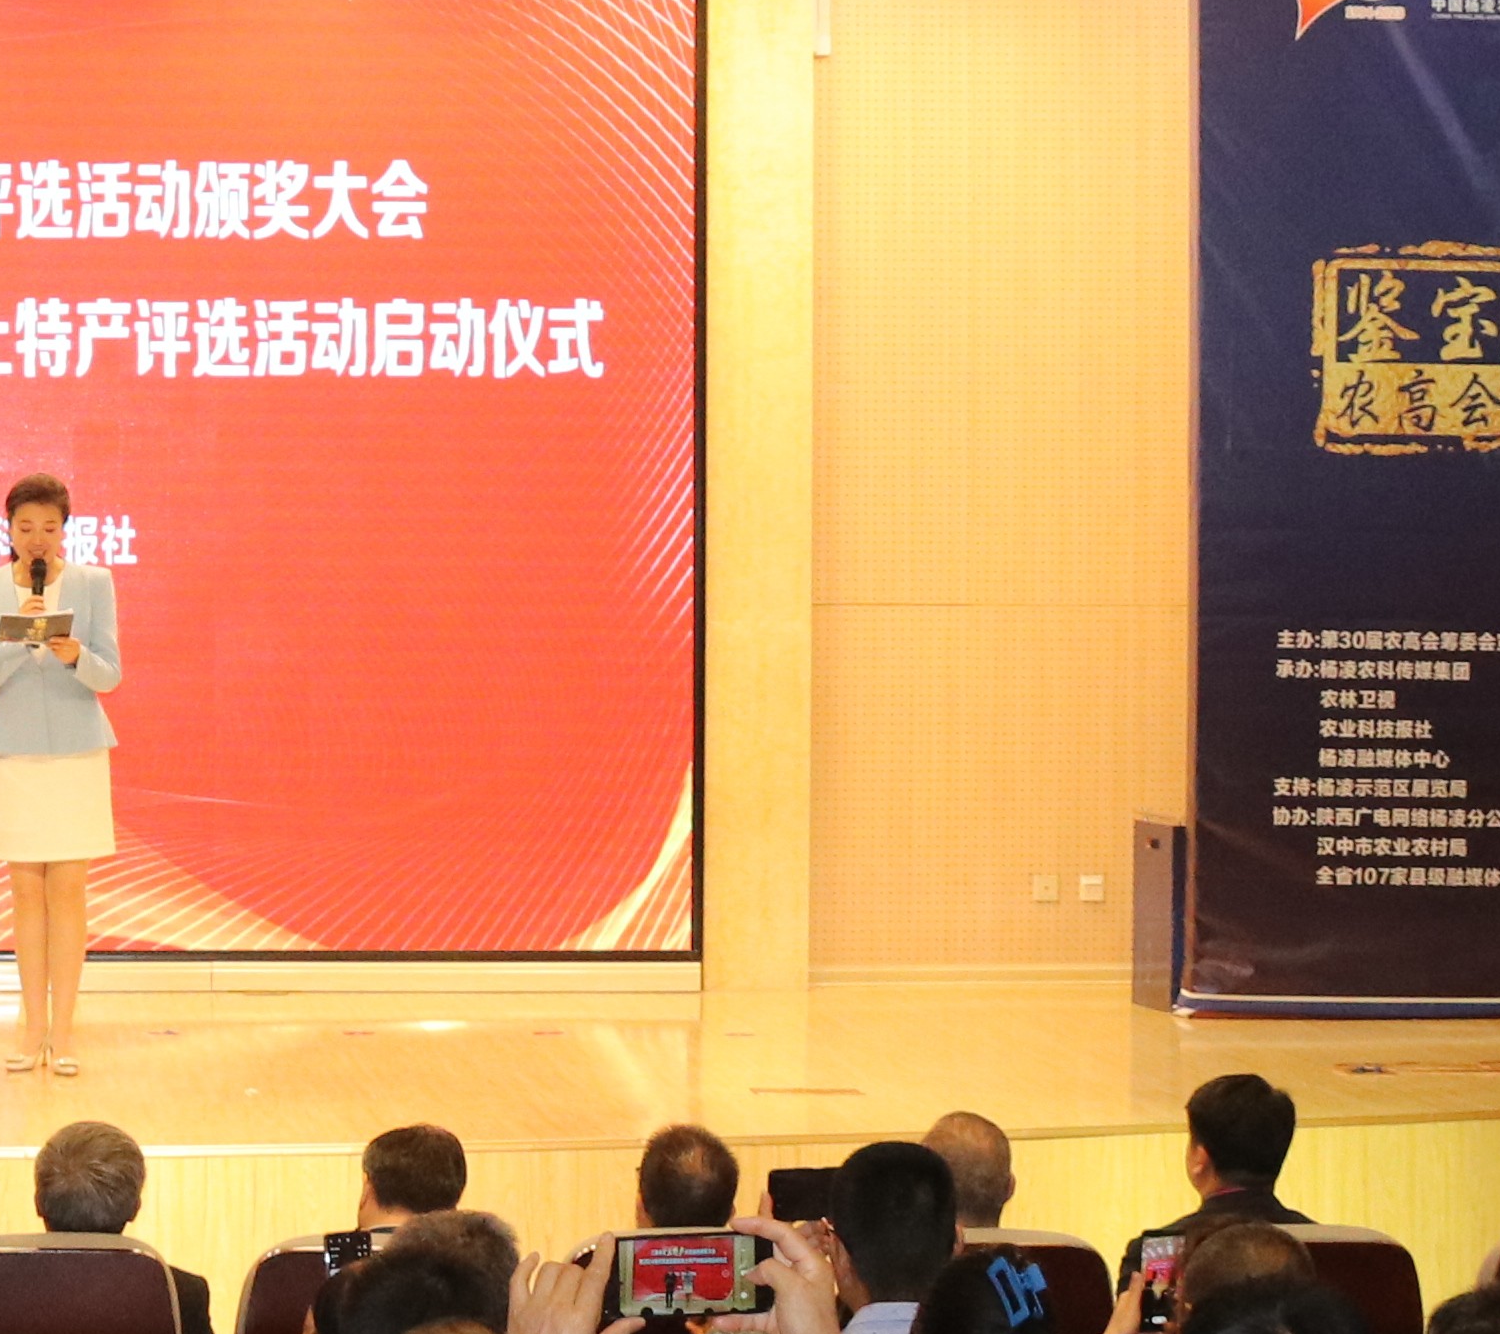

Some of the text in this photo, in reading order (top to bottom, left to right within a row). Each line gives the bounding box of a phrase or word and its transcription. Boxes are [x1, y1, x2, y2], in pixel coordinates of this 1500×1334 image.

[1319, 689, 1396, 710] 农林卫视
[1318, 719, 1433, 740] 农业科技报社
[1318, 748, 1451, 769] 杨凌融媒体中心
[1316, 836, 1468, 858] 汉中市农业农村局
